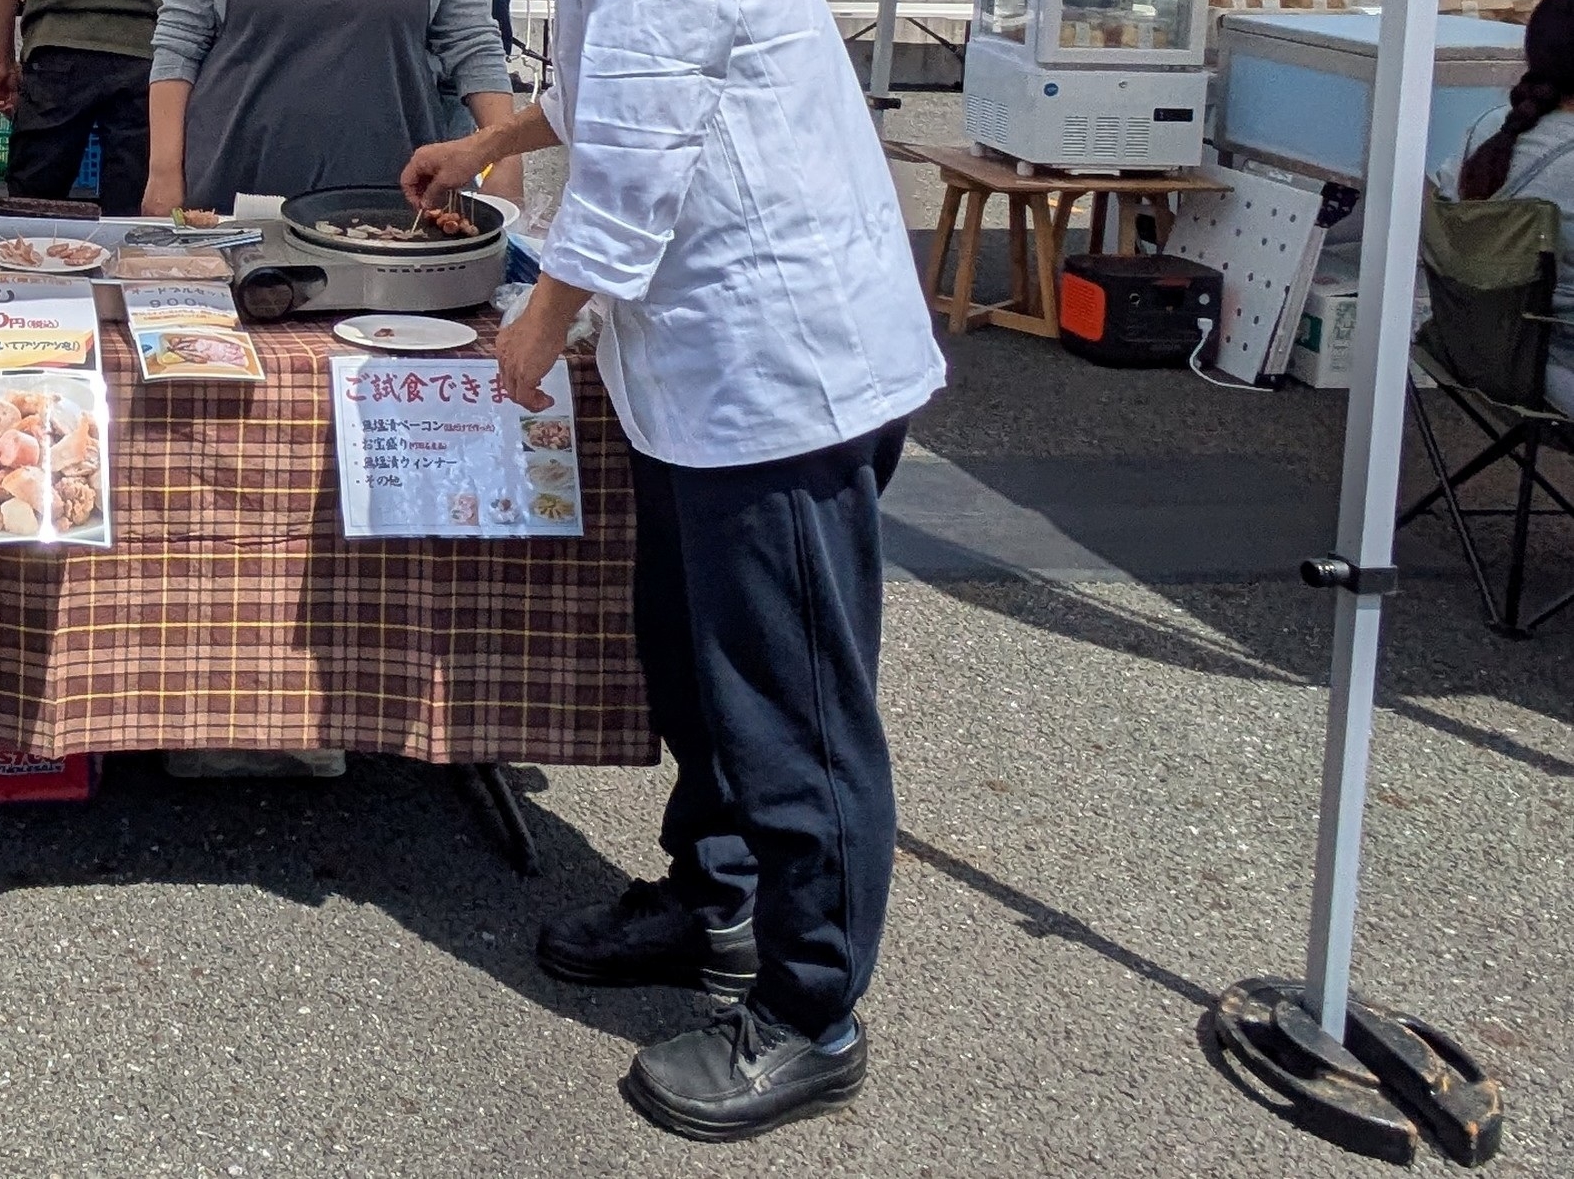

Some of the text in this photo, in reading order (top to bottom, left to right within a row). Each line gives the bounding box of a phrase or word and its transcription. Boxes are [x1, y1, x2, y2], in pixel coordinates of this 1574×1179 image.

[344, 371, 513, 404] ご試食できま
[365, 473, 403, 489] その他
